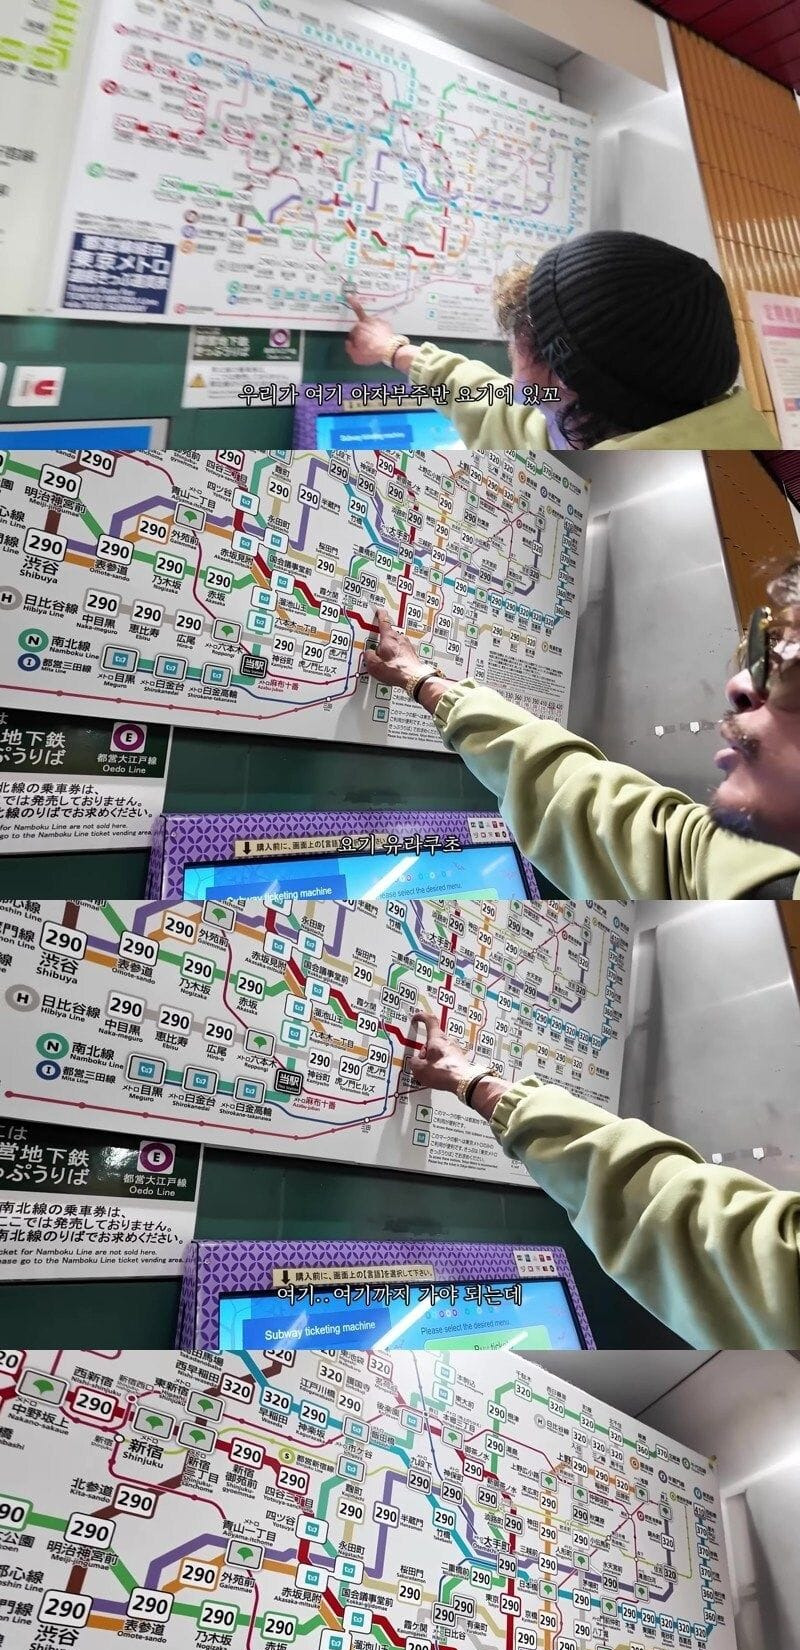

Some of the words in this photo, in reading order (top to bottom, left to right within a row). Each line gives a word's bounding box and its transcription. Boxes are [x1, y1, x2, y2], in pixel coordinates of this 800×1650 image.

[23, 593, 78, 615] 日比谷線
[86, 595, 117, 613] 290
[81, 614, 116, 629] 中目黒
[50, 635, 91, 653] 南北線
[96, 753, 157, 766] 都営大江戸線
[103, 765, 125, 774] Oedo
[129, 766, 146, 775] Line
[123, 1174, 187, 1188] 都営大江戸線
[129, 1186, 154, 1195] Oedo
[157, 1187, 176, 1197] Line
[37, 1248, 74, 1256] Namboku
[76, 1248, 91, 1256] Line
[265, 1328, 303, 1341] Subway
[305, 1325, 340, 1338] ticketing
[343, 1321, 376, 1333] machine
[421, 1327, 445, 1336] Please
[446, 1325, 464, 1334] select
[76, 1393, 112, 1416] 290
[128, 1438, 164, 1461] 新宿
[117, 1490, 153, 1512] 290
[70, 1520, 109, 1542] 290
[36, 1625, 79, 1647] 渋谷
